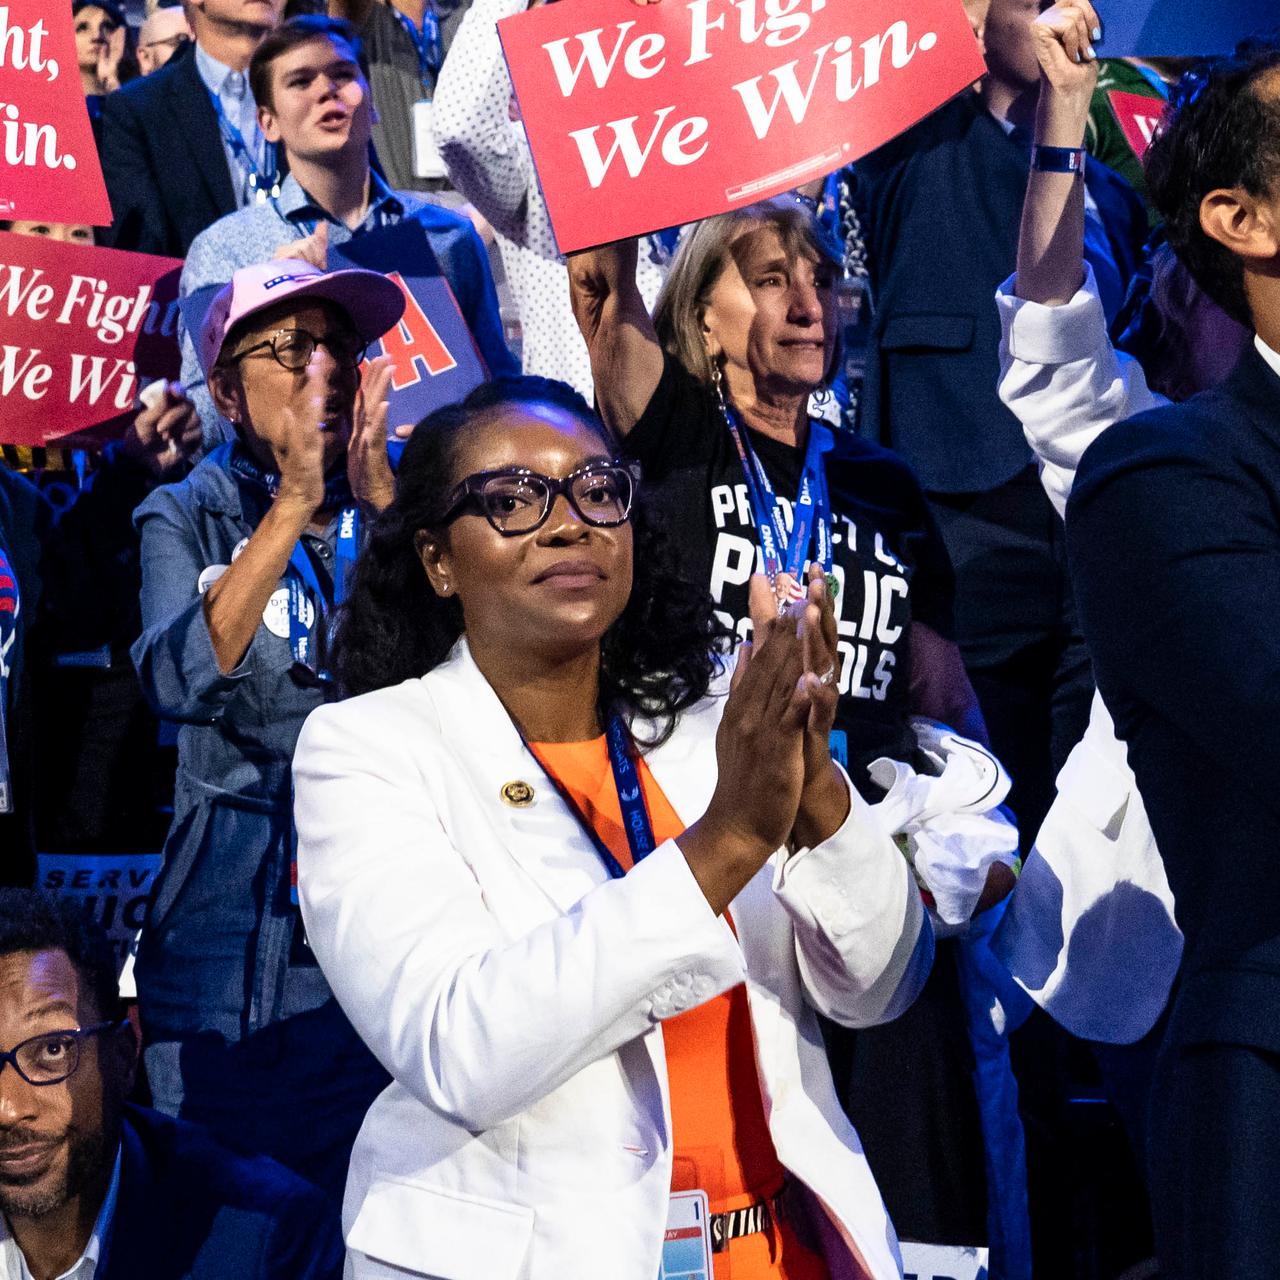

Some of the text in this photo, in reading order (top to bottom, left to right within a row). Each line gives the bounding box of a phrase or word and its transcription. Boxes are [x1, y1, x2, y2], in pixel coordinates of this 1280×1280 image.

[541, 20, 667, 98] We
[568, 105, 710, 190] We
[731, 19, 938, 141] Win.
[68, 354, 138, 411] Wi
[340, 508, 356, 539] DNC
[760, 523, 777, 559] DNC
[629, 809, 650, 851] HOUSE
